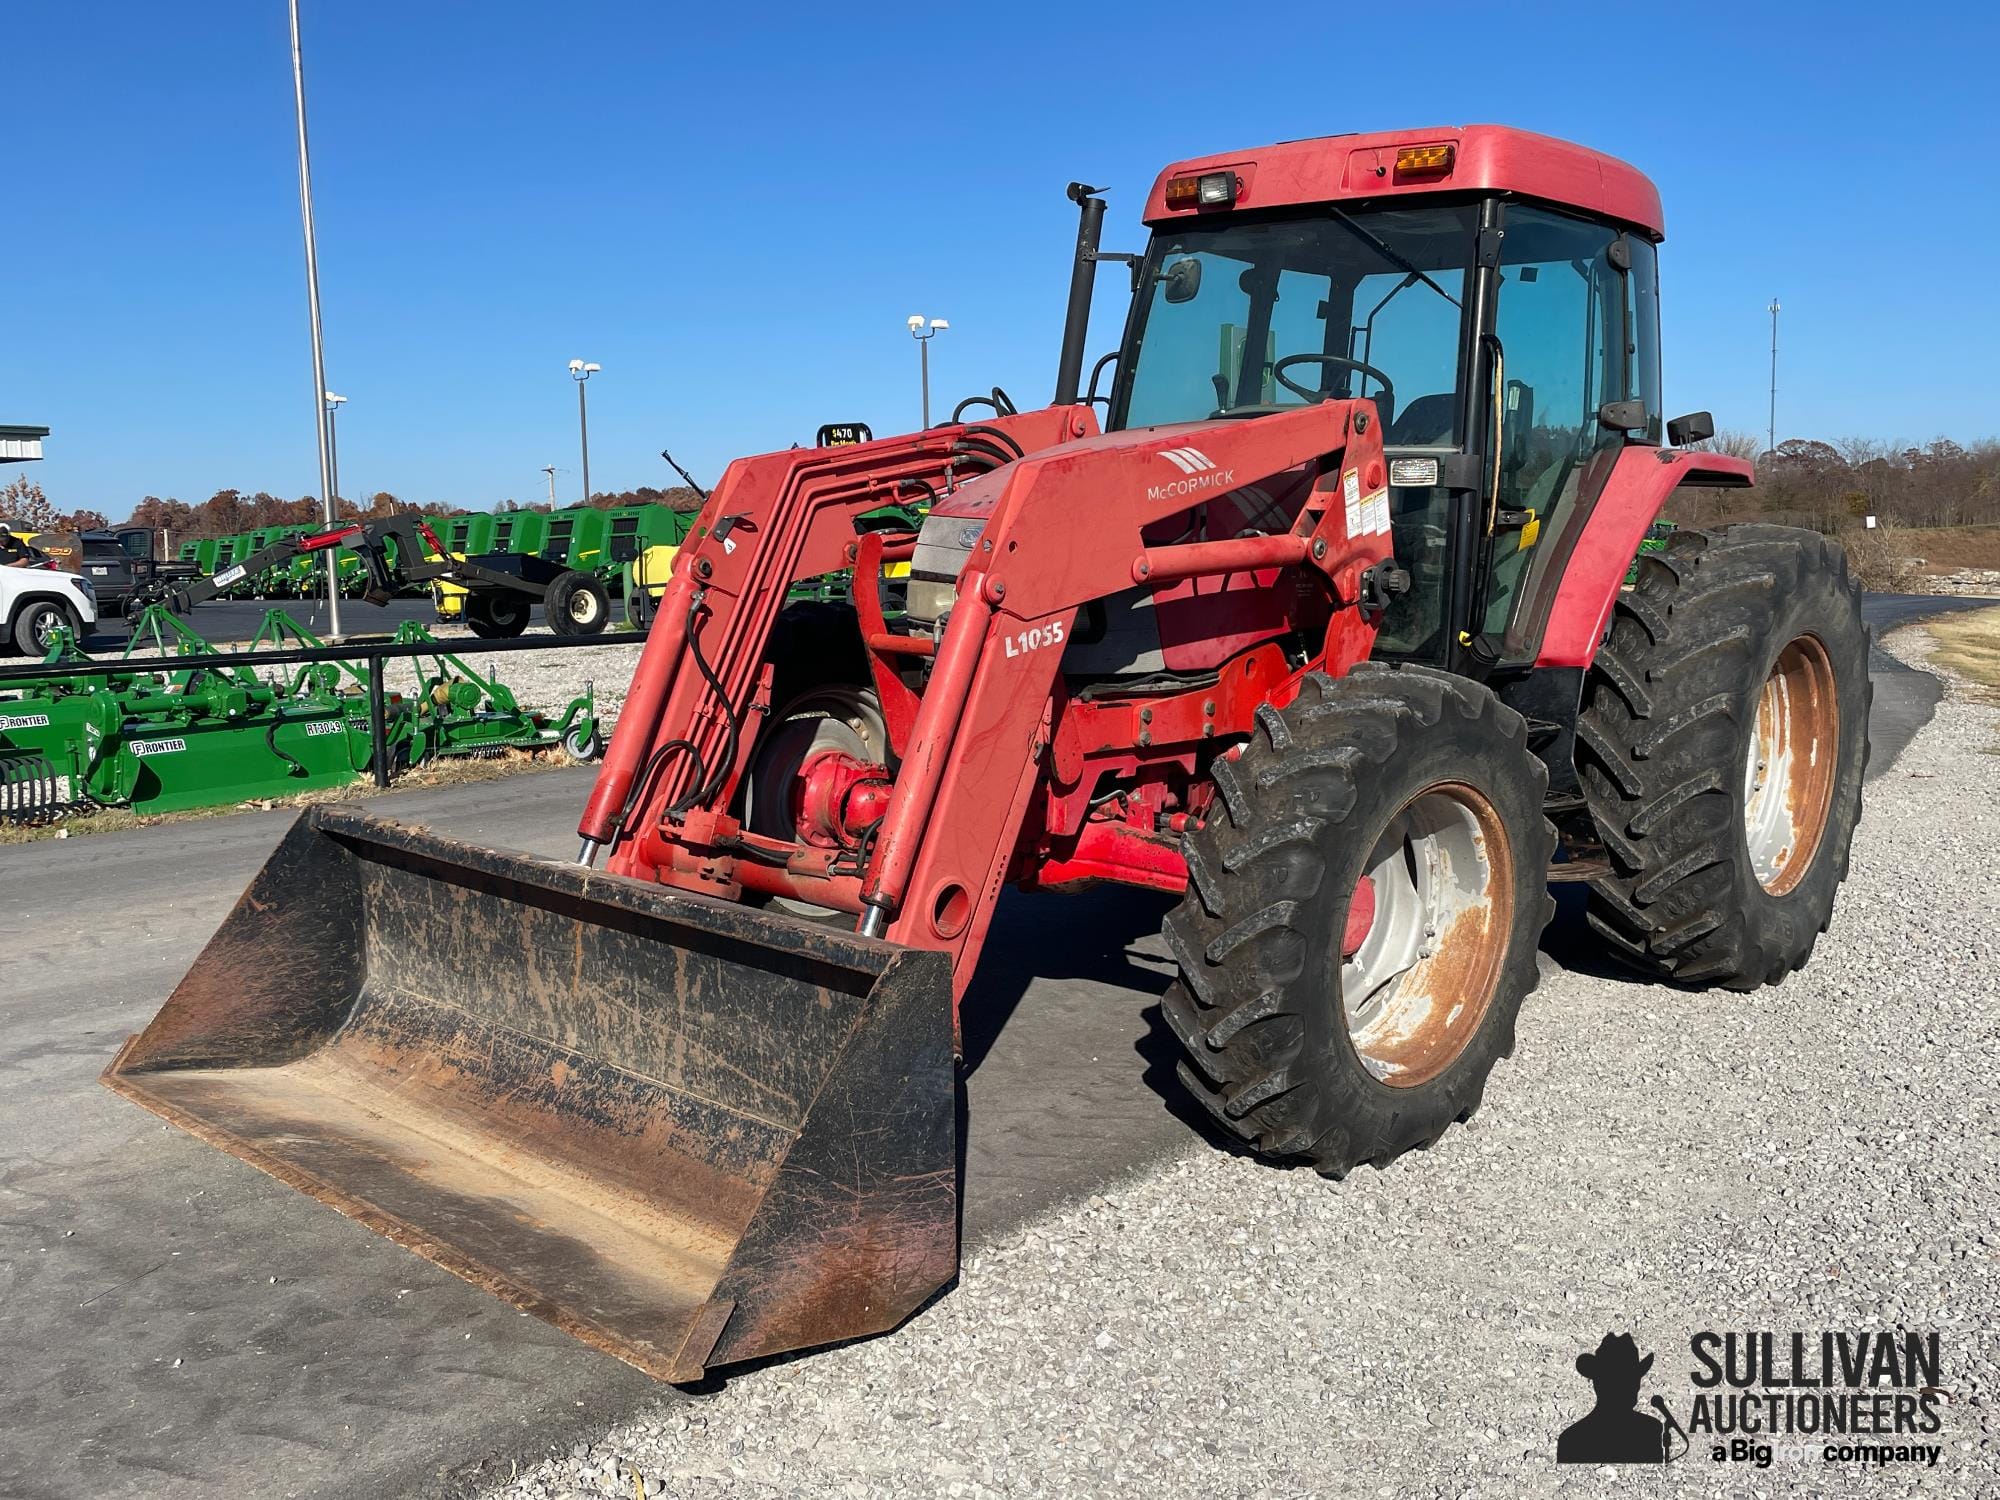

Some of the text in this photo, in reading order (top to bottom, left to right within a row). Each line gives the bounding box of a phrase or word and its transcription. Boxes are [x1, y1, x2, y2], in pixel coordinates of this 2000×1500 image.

[832, 428, 853, 439] $470
[1148, 469, 1234, 500] McCORMICK
[1005, 621, 1064, 658] L1055
[0, 716, 48, 729] FRONTIER
[132, 740, 184, 756] FRONTIER
